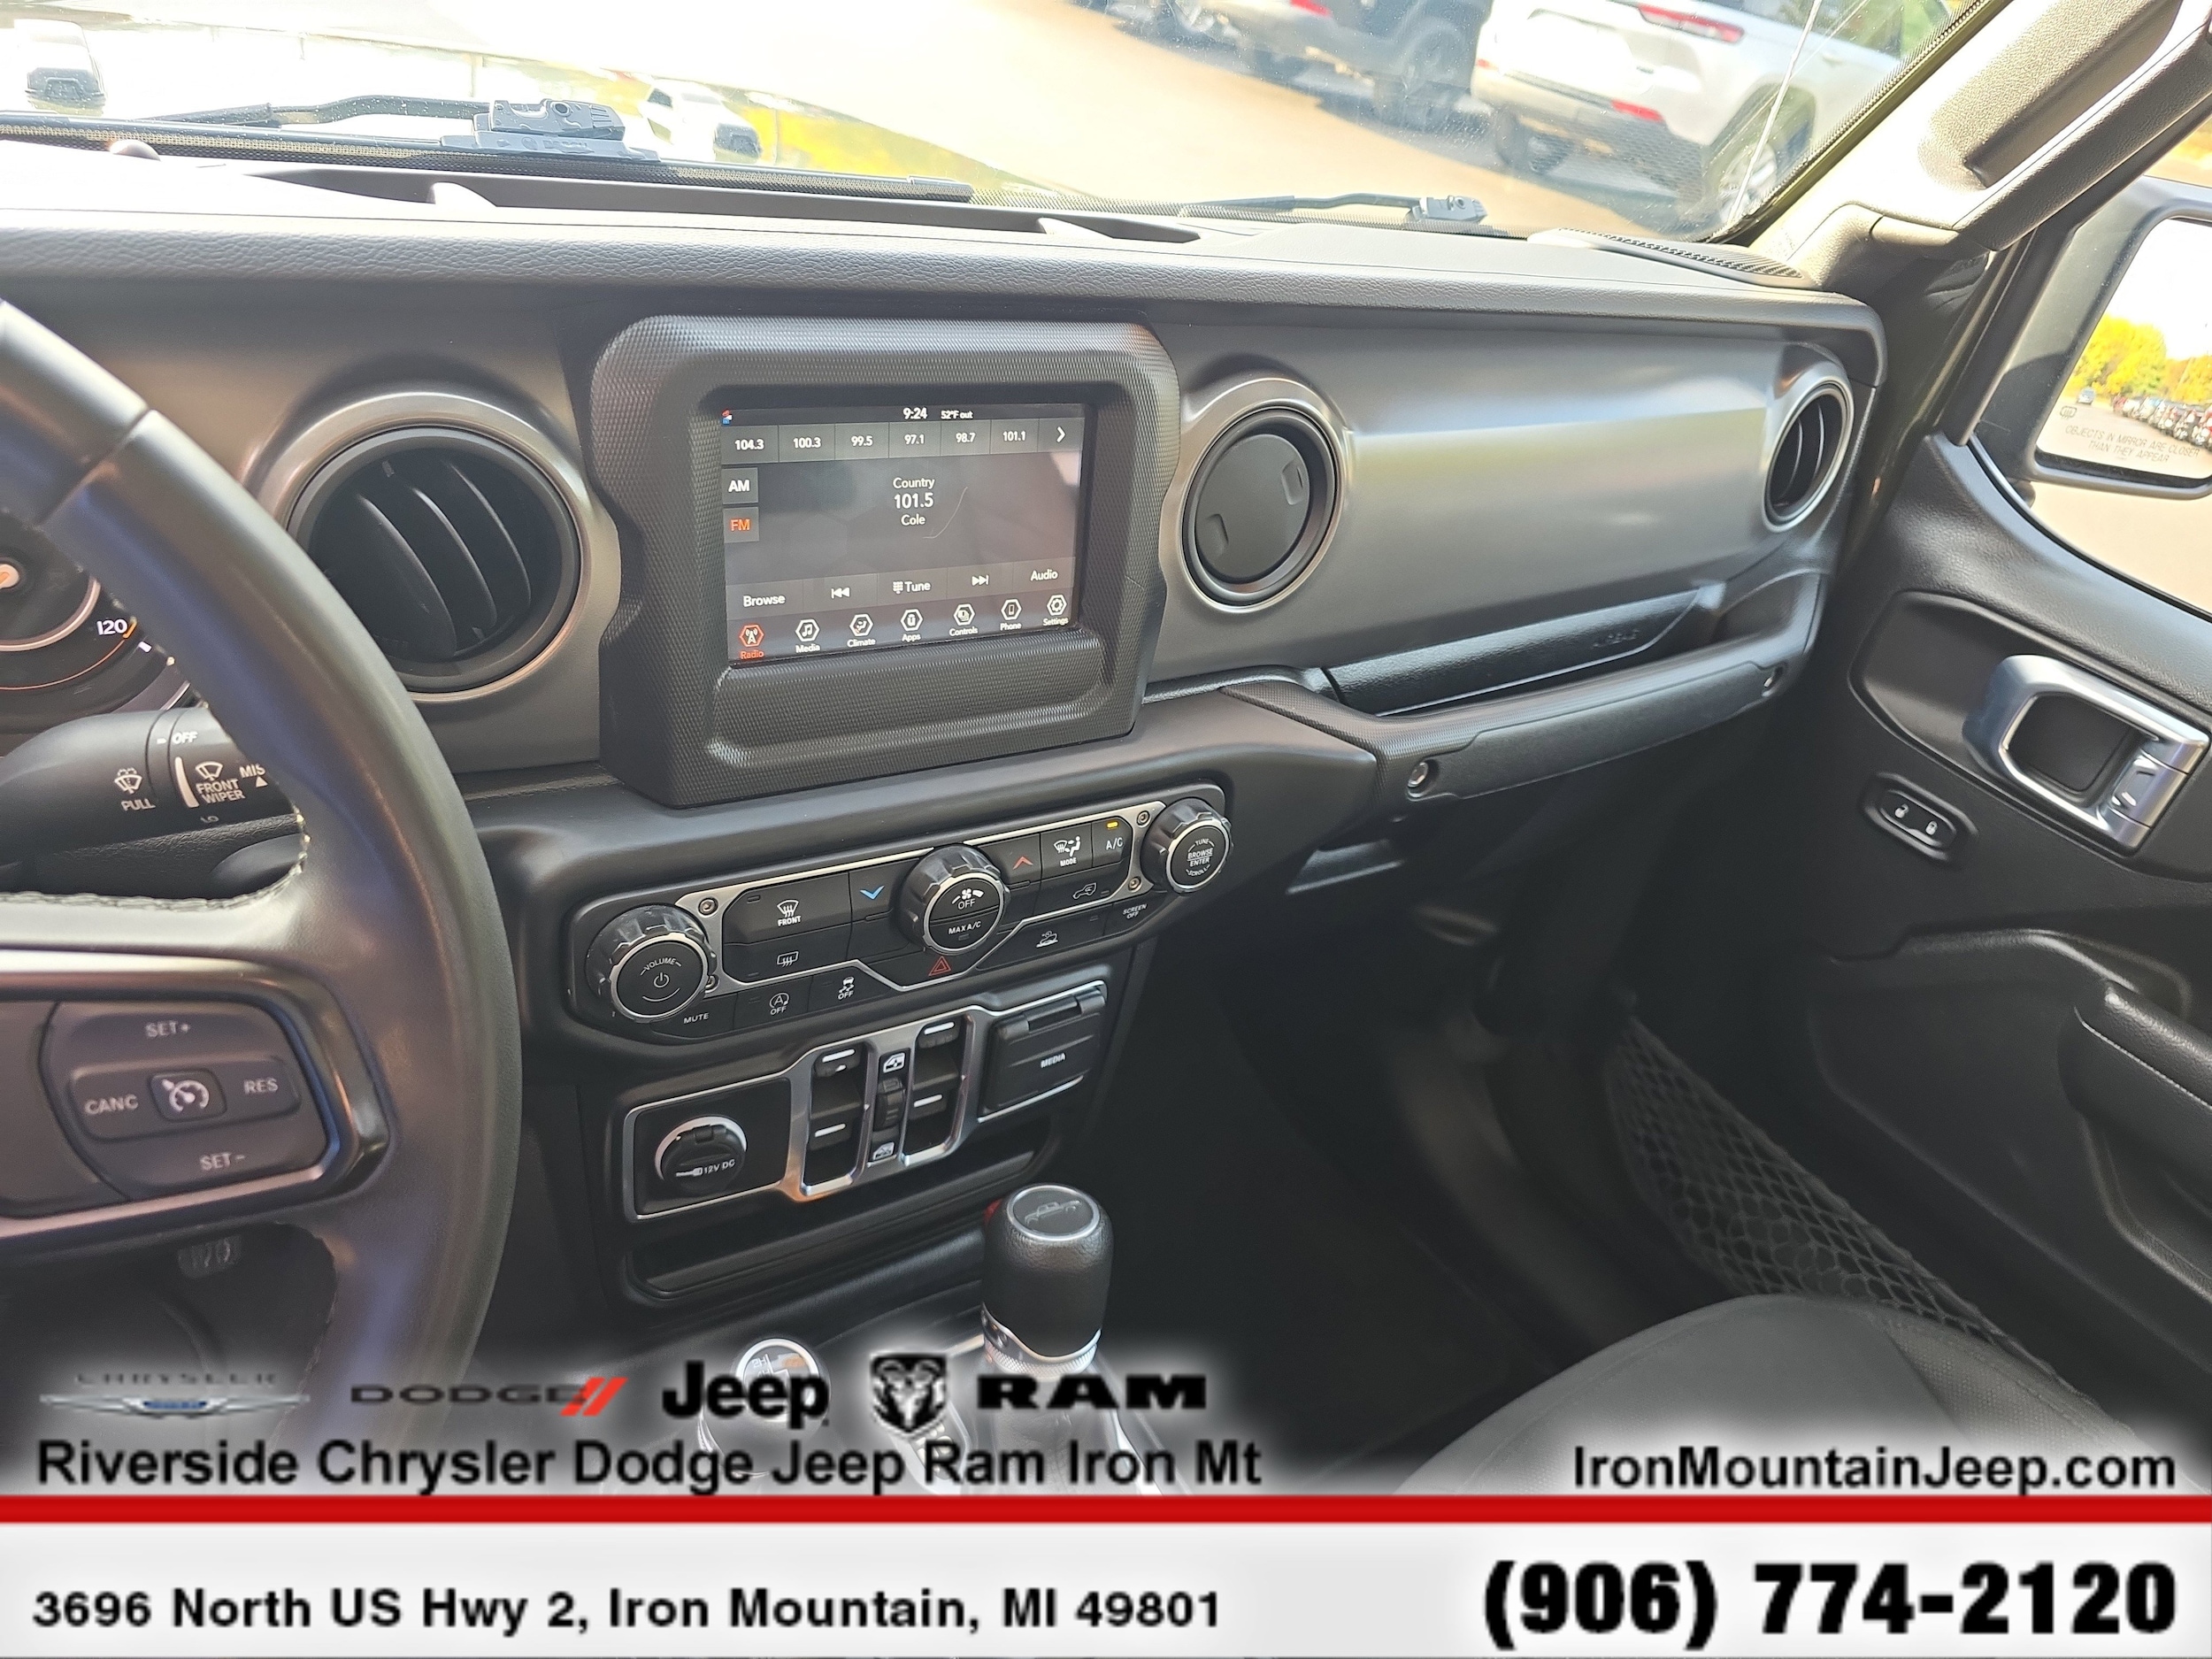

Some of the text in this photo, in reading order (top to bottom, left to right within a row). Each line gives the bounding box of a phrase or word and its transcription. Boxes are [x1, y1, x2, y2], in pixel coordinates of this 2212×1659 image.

[902, 407, 927, 419] 9:24
[959, 411, 973, 419] out
[851, 434, 873, 447] 99.5
[904, 434, 925, 445] 97.1
[956, 432, 976, 443] 98.7
[1002, 430, 1026, 442] 101.1
[2064, 425, 2105, 440] OBJECTS
[2117, 434, 2148, 447] MIRROR
[2148, 441, 2167, 452] ARE
[2168, 444, 2200, 457] CLOSER
[734, 439, 764, 451] 104.3
[793, 437, 821, 449] 100.3
[2088, 440, 2170, 462] THAN THEY APPEAR
[728, 480, 750, 493] AM
[893, 476, 935, 490] Country
[894, 493, 934, 509] 101.5
[731, 518, 750, 531] FM
[901, 514, 926, 526] Cole
[1030, 568, 1058, 581] Audio
[904, 580, 931, 593] Tune
[743, 593, 786, 607] Browse
[96, 618, 128, 635] 120
[1000, 621, 1022, 632] Phone
[1042, 615, 1069, 626] Settings
[949, 625, 979, 636] Controls
[847, 637, 876, 649] Climate
[902, 632, 921, 643] Apps
[795, 642, 820, 654] Media
[741, 649, 764, 660] Radio
[172, 732, 198, 744] OFF
[239, 764, 266, 779] MIS
[196, 778, 239, 795] FRONT
[202, 789, 245, 804] WIPER
[120, 798, 156, 811] PULL
[1106, 837, 1124, 850] A/C
[1187, 848, 1213, 859] BROWSE
[1060, 857, 1077, 867] MODE
[1189, 857, 1210, 867] ENTER
[1187, 867, 1208, 877] SCROLL
[957, 898, 976, 910] OFF
[1122, 903, 1148, 915] SCREEN
[777, 915, 802, 926] FRONT
[948, 921, 982, 935] MAX A/C
[643, 957, 676, 972] VOLUME
[837, 990, 855, 1000] OFF
[770, 1005, 787, 1016] OFF
[683, 1013, 710, 1025] MUTE
[1041, 1053, 1066, 1068] MEDIA
[244, 1077, 279, 1094] RES
[84, 1094, 139, 1116] CANC
[703, 1158, 735, 1174] 12V DC
